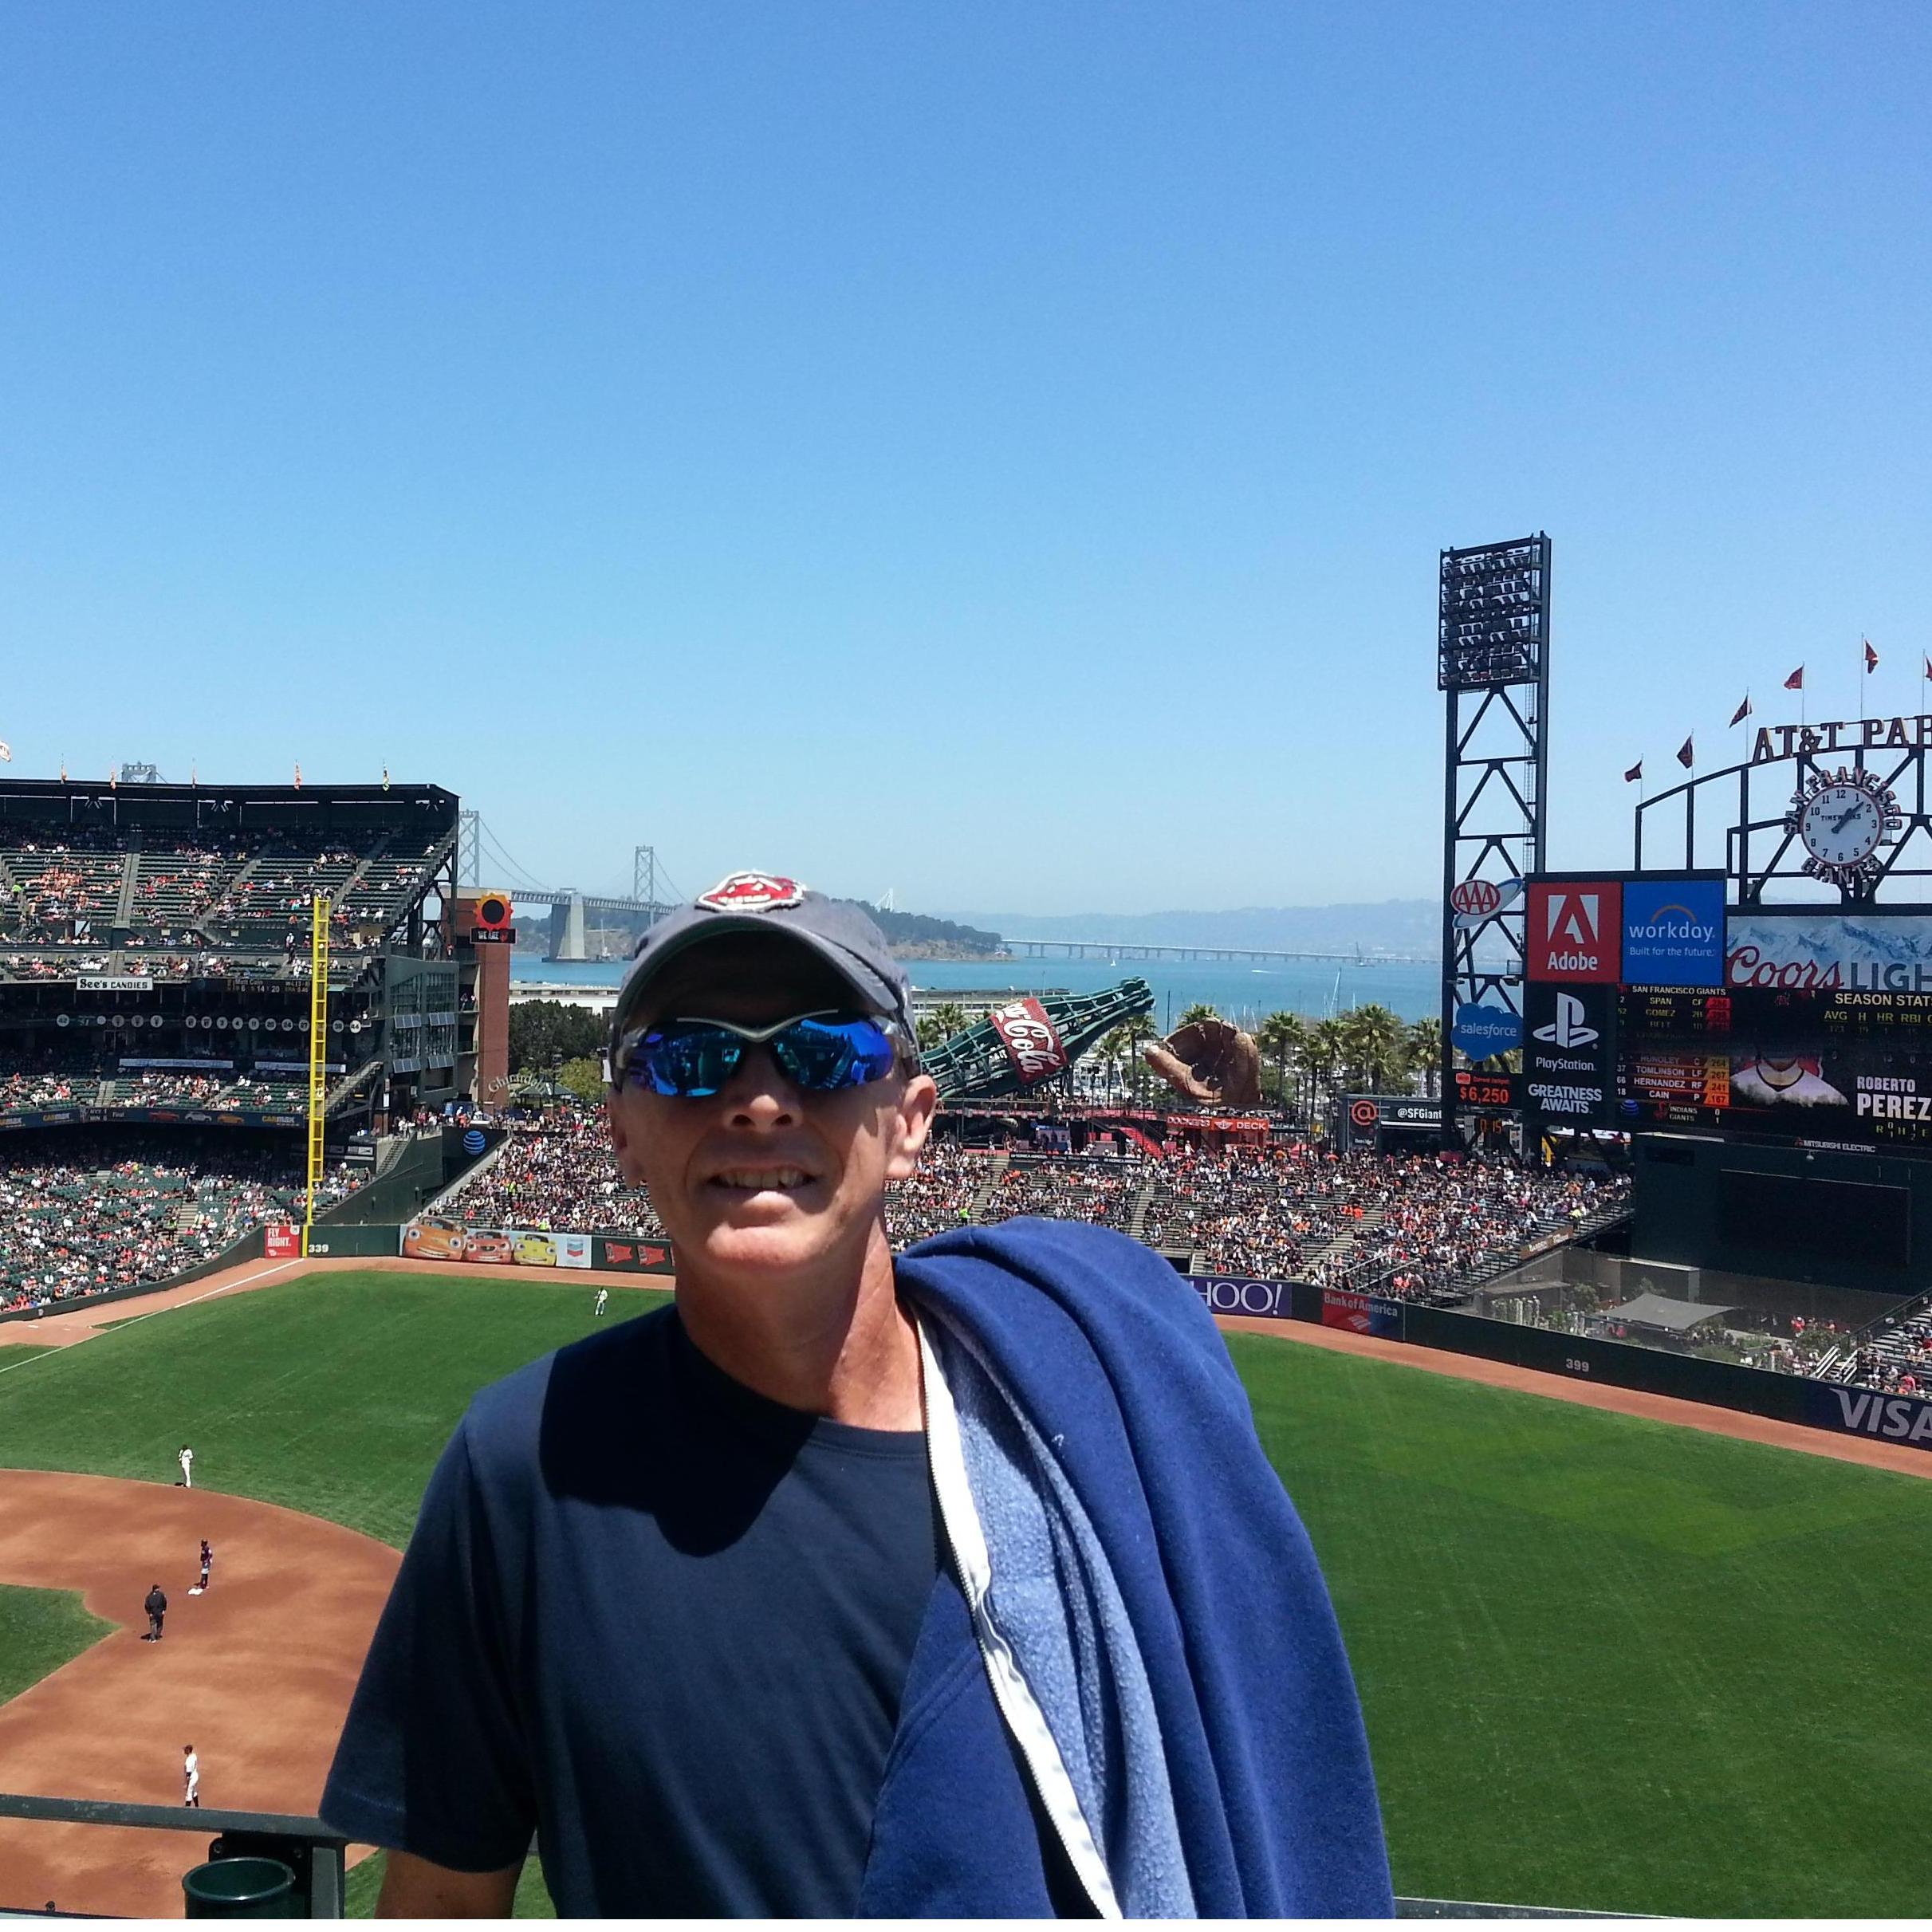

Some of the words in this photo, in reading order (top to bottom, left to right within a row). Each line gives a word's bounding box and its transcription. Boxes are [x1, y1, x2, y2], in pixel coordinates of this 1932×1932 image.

[1753, 726, 1846, 763] AT&T
[1822, 795, 1830, 804] 11
[1836, 790, 1846, 799] 12
[1811, 807, 1820, 816] 10
[1866, 804, 1872, 813] 2
[1805, 822, 1811, 831] 9
[1871, 820, 1877, 828] 3
[1864, 836, 1871, 845] 4
[1823, 848, 1828, 857] 7
[1837, 852, 1843, 861] 6
[1853, 848, 1859, 856] 5
[1800, 854, 1883, 883] GIANTS
[1454, 883, 1497, 913] AAA
[1630, 946, 1650, 956] Built
[1652, 946, 1665, 956] for
[1667, 946, 1682, 956] the
[1548, 951, 1598, 971] Adobe
[1726, 946, 1844, 990] Coors
[80, 979, 108, 989] See's
[1650, 986, 1694, 995] FRANCISCO
[1835, 993, 1892, 1005] SEASON
[1824, 1010, 1848, 1021] AVG
[1858, 1012, 1867, 1021] H
[1876, 1013, 1895, 1022] HR
[1900, 1013, 1922, 1023] RBI
[1460, 1023, 1517, 1038] salesforce
[1536, 1057, 1595, 1072] PlayStation
[1636, 1065, 1685, 1076] TOMLINSON
[1634, 1077, 1686, 1088] HERNANDEZ
[1857, 1076, 1916, 1093] ROBERTO
[1460, 1086, 1509, 1104] $6,250
[1529, 1084, 1603, 1102] GREATNESS
[1649, 1090, 1670, 1100] CAIN
[1540, 1099, 1590, 1114] AWAITS
[1670, 1106, 1698, 1115] INDIANS
[1857, 1093, 1931, 1121] PEREZ
[1236, 1121, 1267, 1130] DECK
[1804, 1140, 1841, 1150] MITSUBISHI
[1842, 1143, 1876, 1153] ELECTRIC
[268, 1227, 280, 1237] FLY
[309, 1244, 329, 1253] 339
[1324, 1293, 1347, 1307] Bank
[1347, 1297, 1359, 1309] of
[1358, 1299, 1398, 1316] America
[1565, 1357, 1590, 1373] 399
